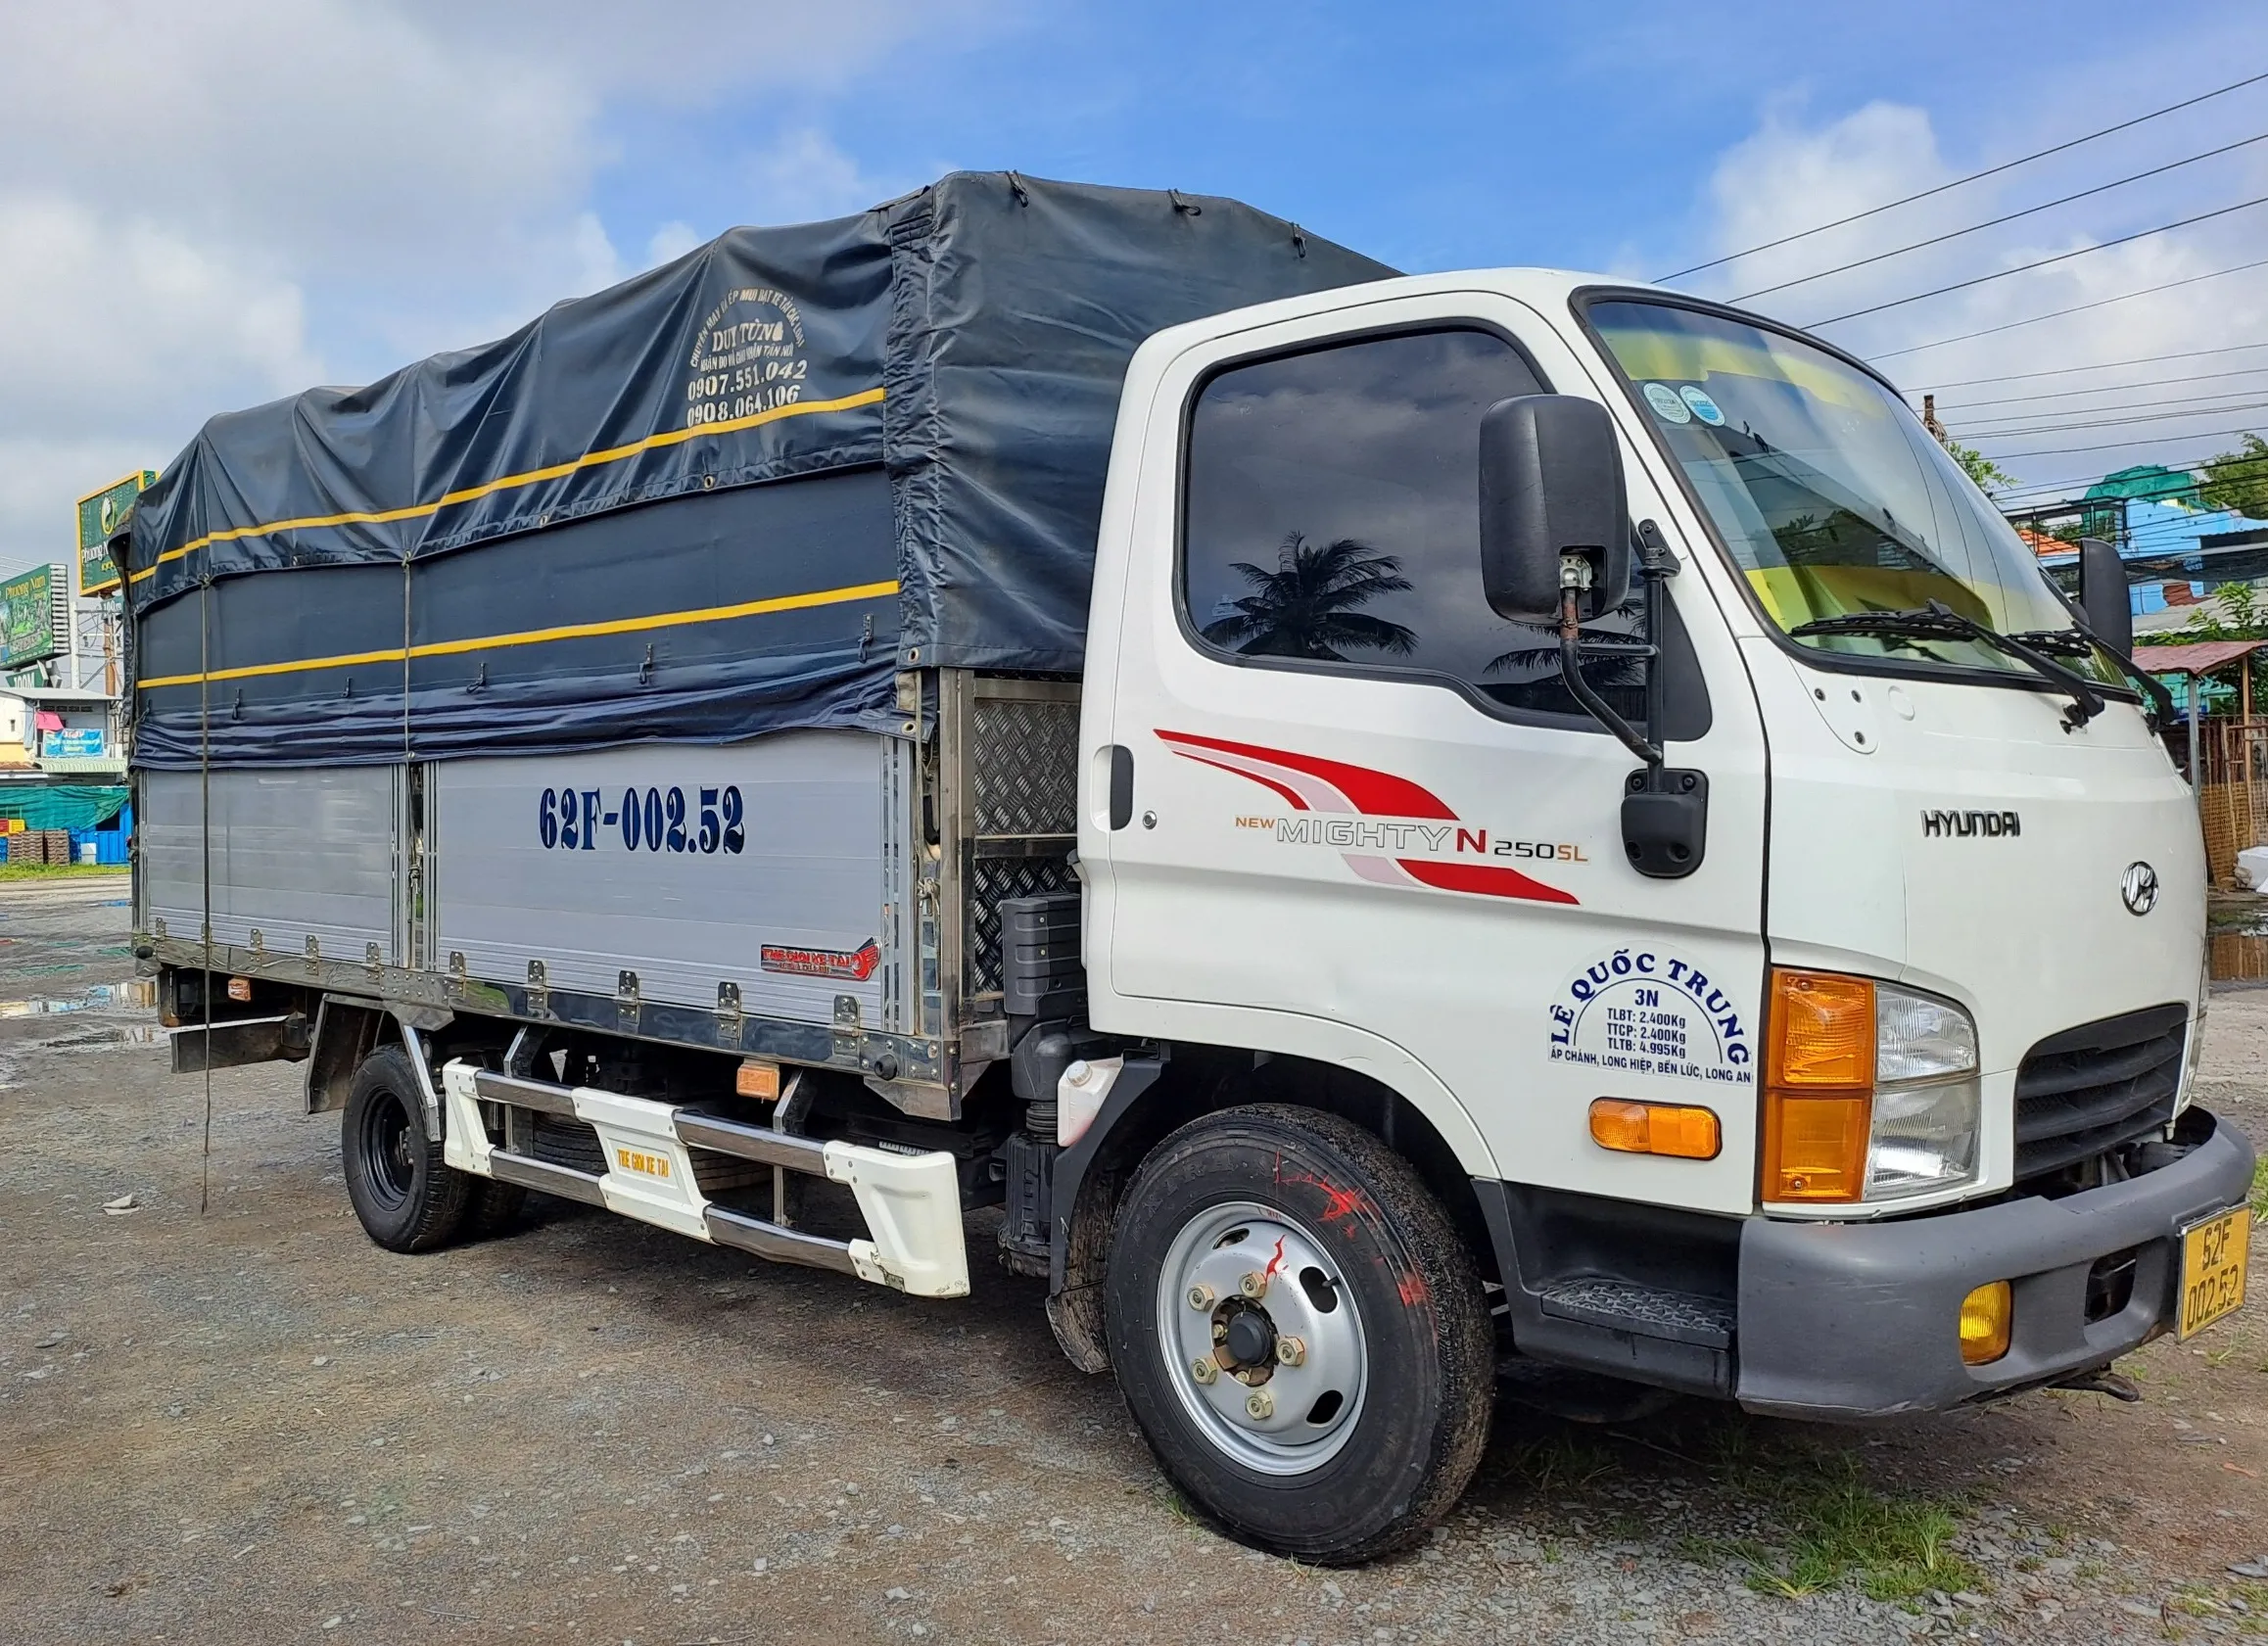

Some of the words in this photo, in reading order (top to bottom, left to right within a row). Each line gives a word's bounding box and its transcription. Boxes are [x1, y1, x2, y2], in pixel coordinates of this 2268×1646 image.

[706, 306, 722, 330] MAY
[771, 292, 783, 306] XE
[712, 325, 737, 353] DUY
[738, 318, 783, 344] TÙNG
[687, 359, 808, 401] 0907.551.042
[686, 384, 801, 428] 0908.064.106
[539, 784, 746, 855] 62F-002.52
[1235, 815, 1275, 829] NEW
[1276, 817, 1452, 852] MIGHTY
[1456, 828, 1487, 855] N
[1493, 839, 1589, 863] 250SL
[1920, 810, 2021, 837] HYUNDAI
[1549, 1003, 1576, 1046] LÊ
[1667, 958, 1750, 1065] TRUNG
[1634, 989, 1659, 1008] 3N
[1607, 1008, 1636, 1022] TLBT:
[1639, 1011, 1686, 1029] 2.400Kg
[1607, 1022, 1637, 1038] TTCP:
[1640, 1025, 1686, 1045] 2.400Kg
[1550, 1045, 1563, 1060] ẤP
[1565, 1048, 1599, 1067] CHÁNH,
[1601, 1055, 1628, 1069] LONG
[1630, 1057, 1655, 1075] HIỆP,
[1657, 1058, 1677, 1074] BẾN
[1679, 1061, 1703, 1081] LỨC,
[1705, 1067, 1733, 1082] LONG
[1735, 1070, 1751, 1084] AN
[1607, 1037, 1636, 1053] TLTB:
[1639, 1040, 1686, 1058] 4.995Kg
[2201, 1217, 2233, 1271] 62F
[2187, 1264, 2239, 1331] 002.52
